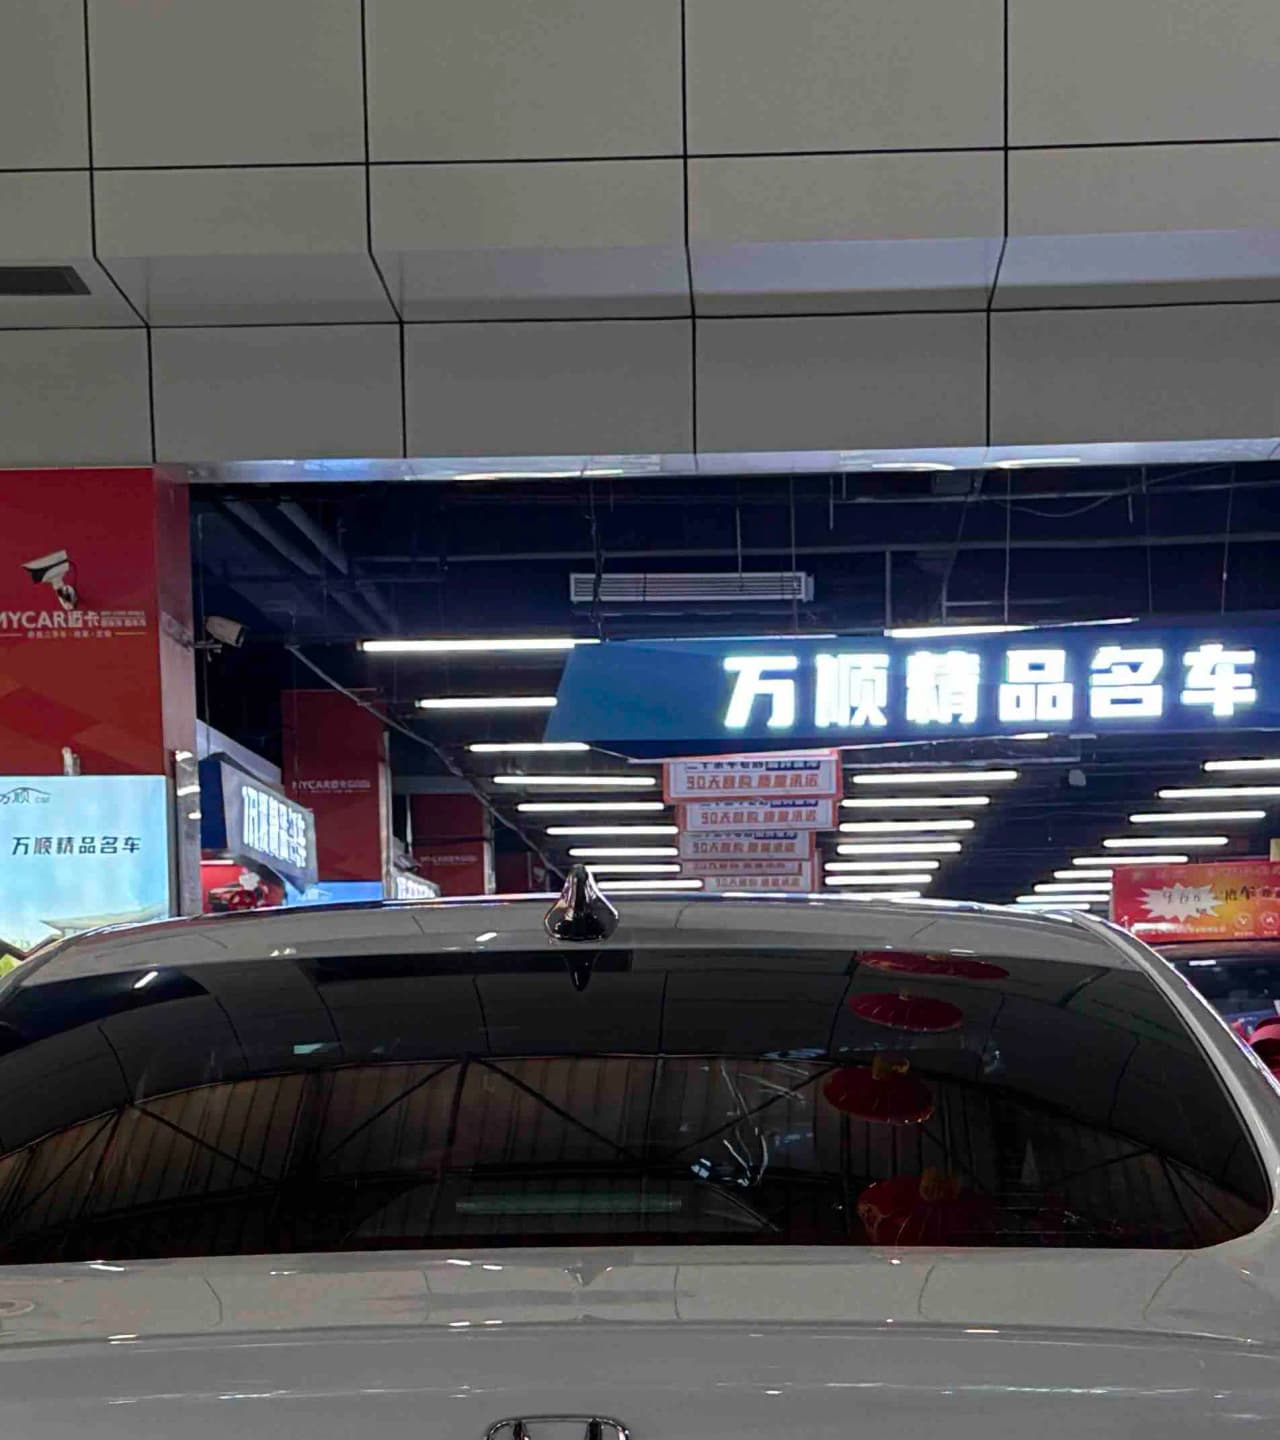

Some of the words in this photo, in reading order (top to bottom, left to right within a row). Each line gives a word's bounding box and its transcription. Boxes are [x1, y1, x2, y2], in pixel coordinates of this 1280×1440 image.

[723, 644, 1258, 729] 万顺精品名车
[11, 835, 142, 856] 万顺精品名车
